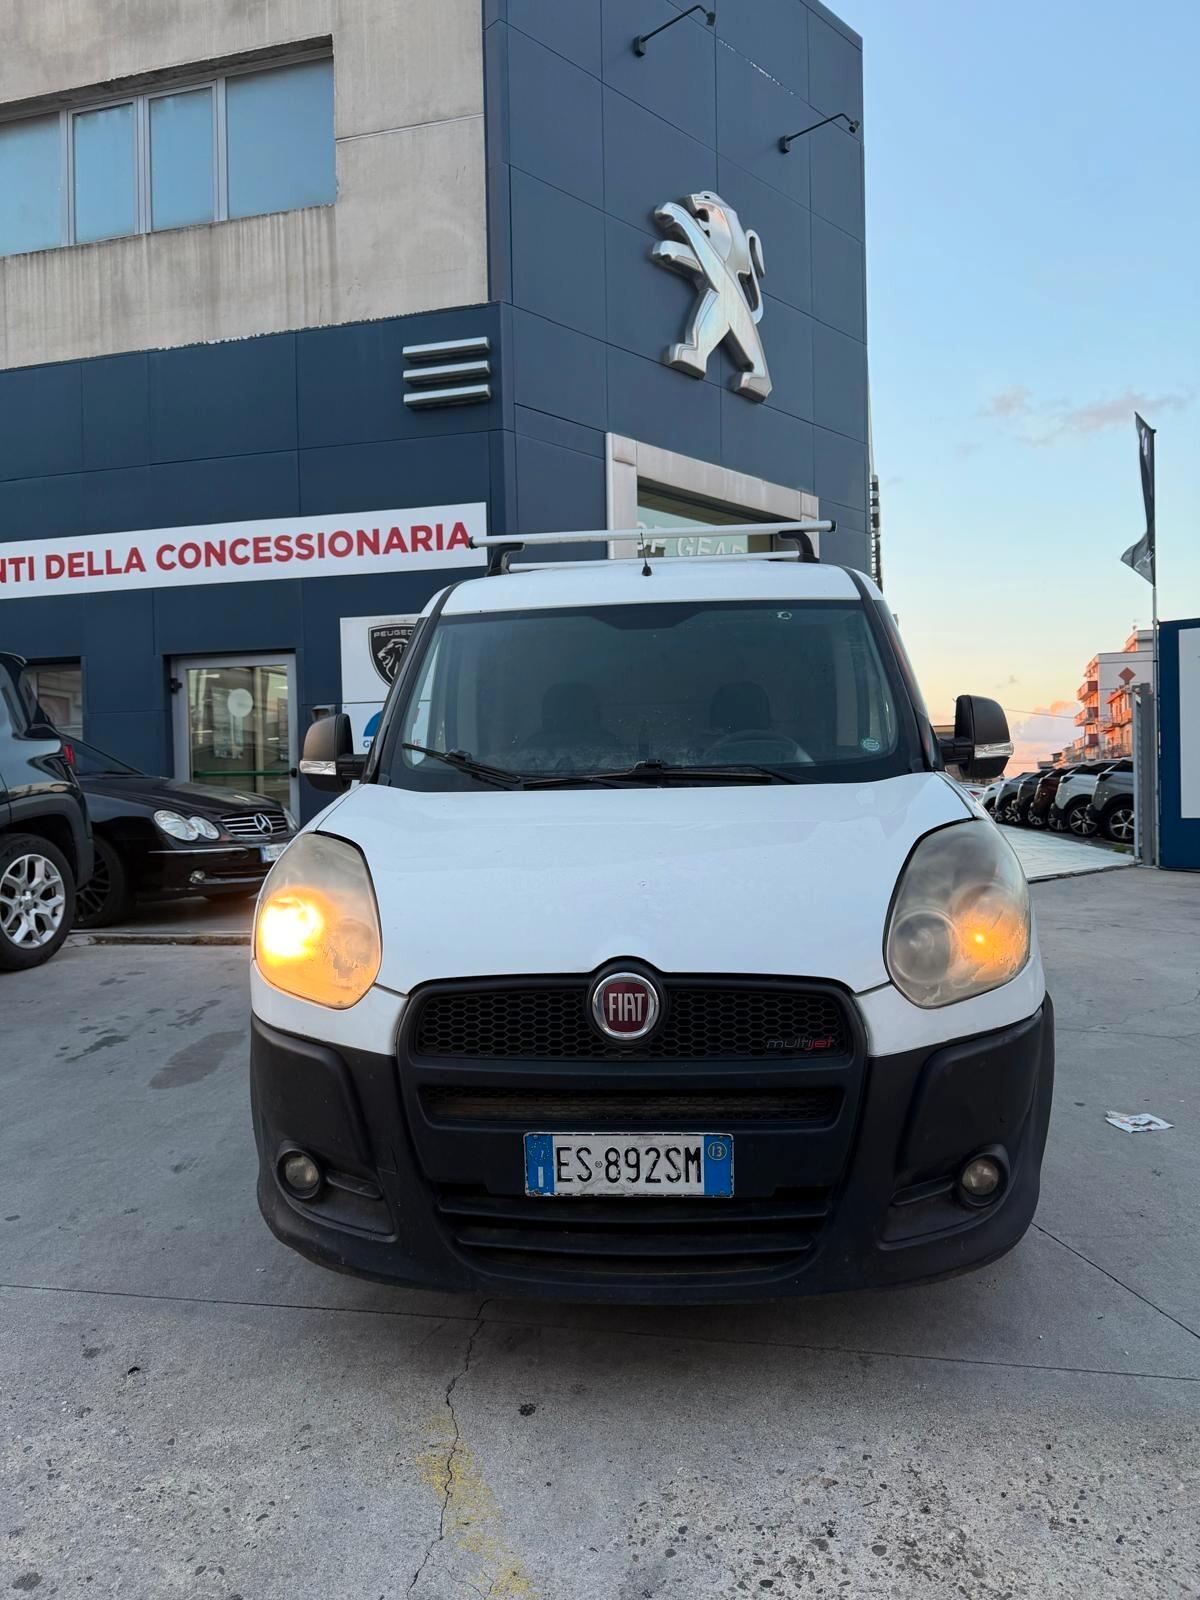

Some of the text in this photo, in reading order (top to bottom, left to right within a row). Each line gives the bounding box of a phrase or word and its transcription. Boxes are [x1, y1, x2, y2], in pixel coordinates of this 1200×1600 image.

[45, 547, 146, 580] DELLA
[156, 521, 471, 571] CONCESSIONARIA
[373, 629, 413, 638] PEUGEO
[608, 992, 646, 1022] FIAT
[766, 1033, 835, 1052] multijet
[711, 1145, 723, 1157] 13
[556, 1146, 703, 1184] ES 892SM
